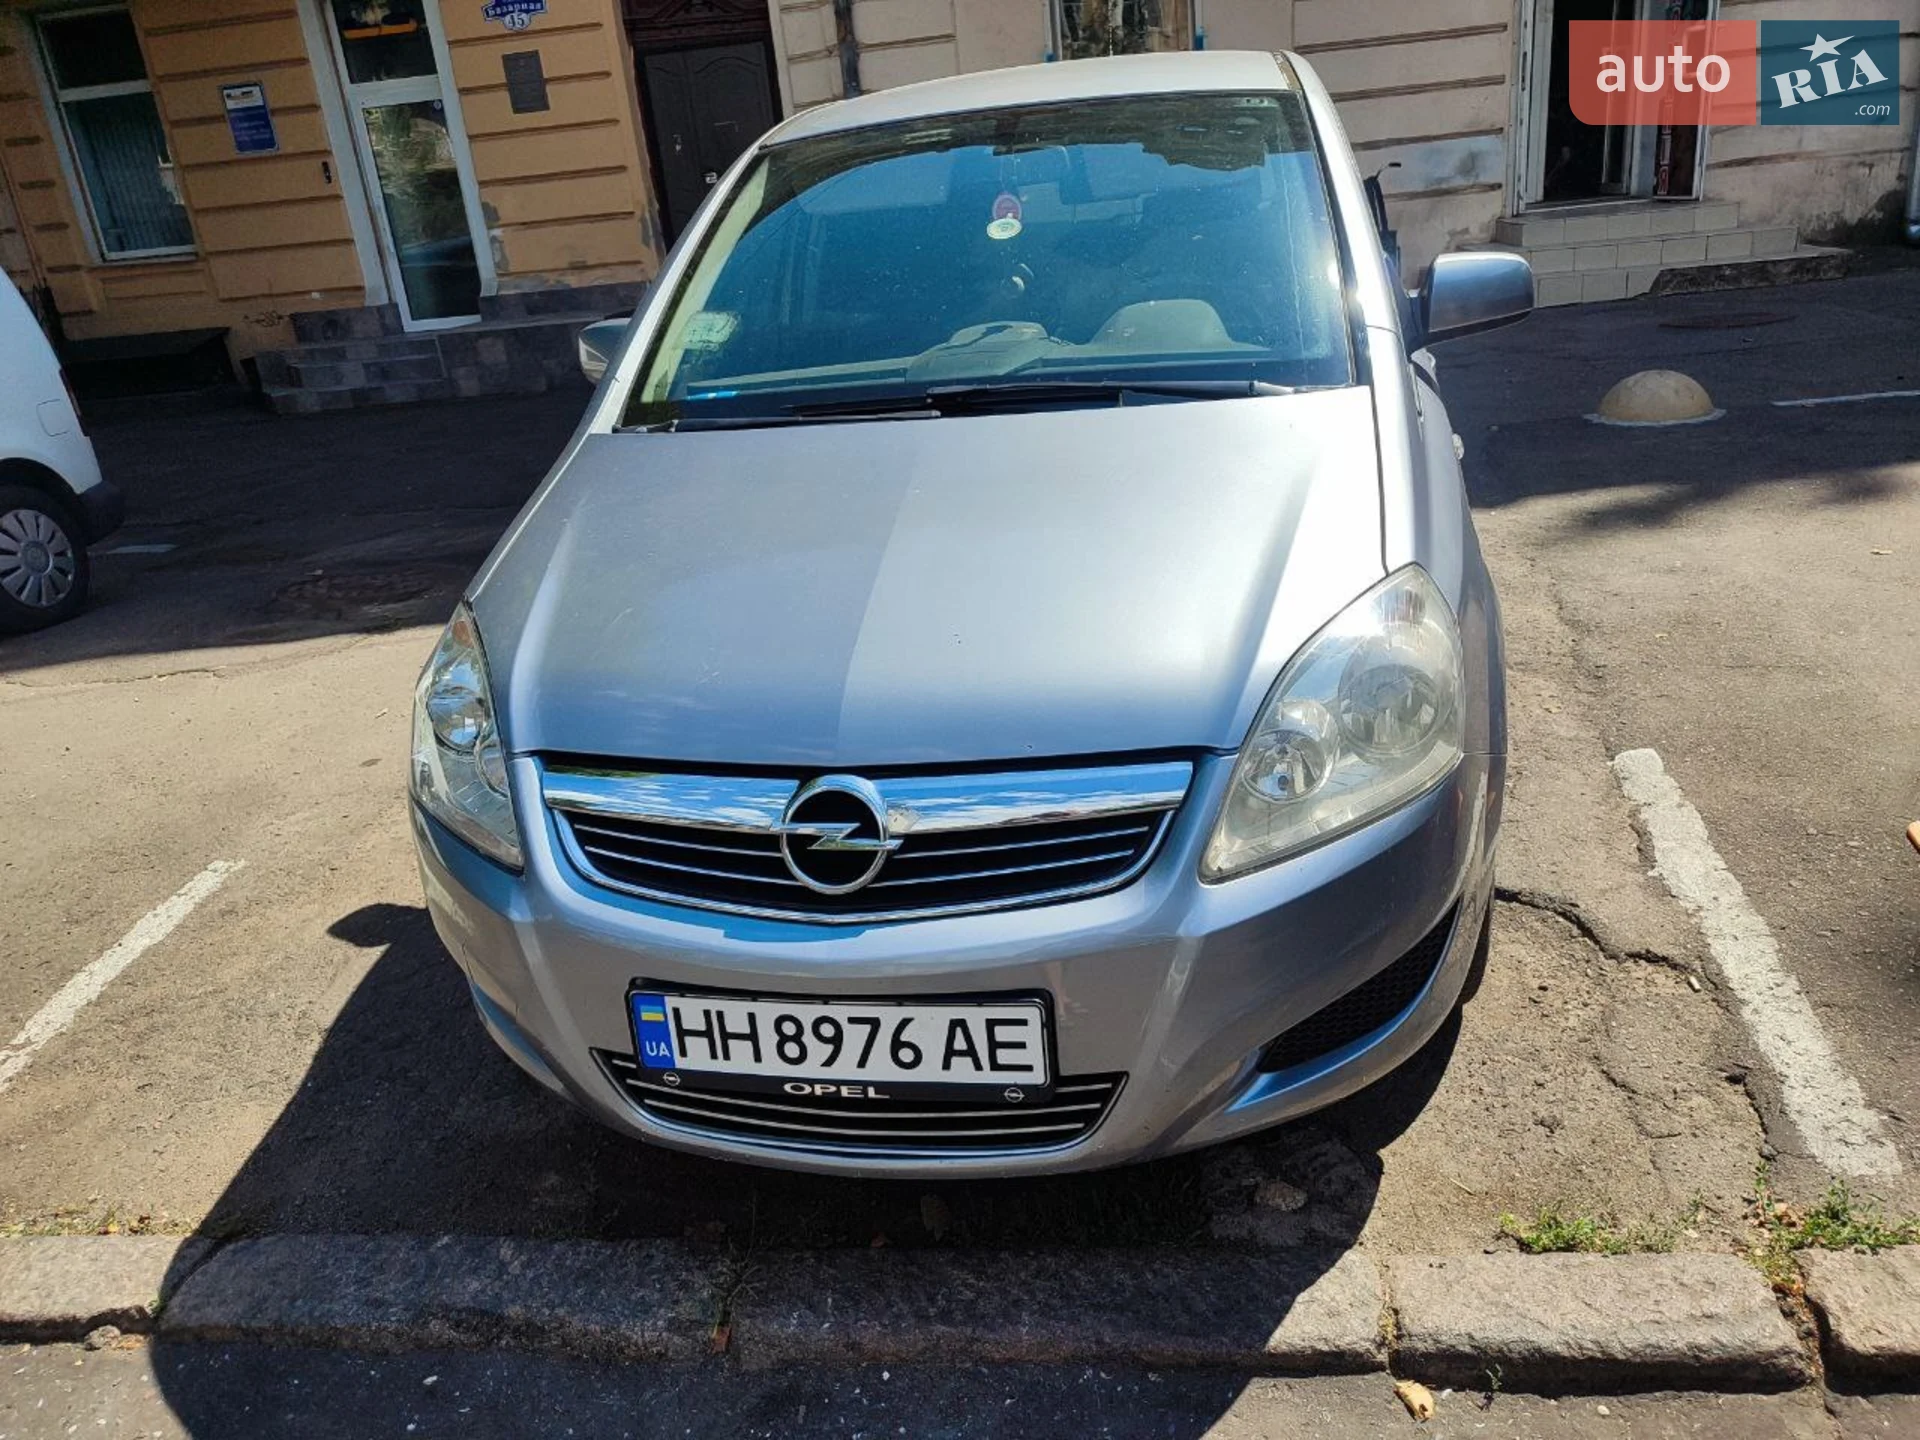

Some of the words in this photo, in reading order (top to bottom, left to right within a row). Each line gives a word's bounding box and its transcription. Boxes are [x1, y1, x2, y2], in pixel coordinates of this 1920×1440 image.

[507, 13, 525, 28] 45
[672, 1006, 763, 1064] HH
[773, 1013, 923, 1070] 8976
[941, 1017, 1035, 1073] AE
[645, 1040, 672, 1059] UA
[783, 1082, 890, 1100] OPEL
